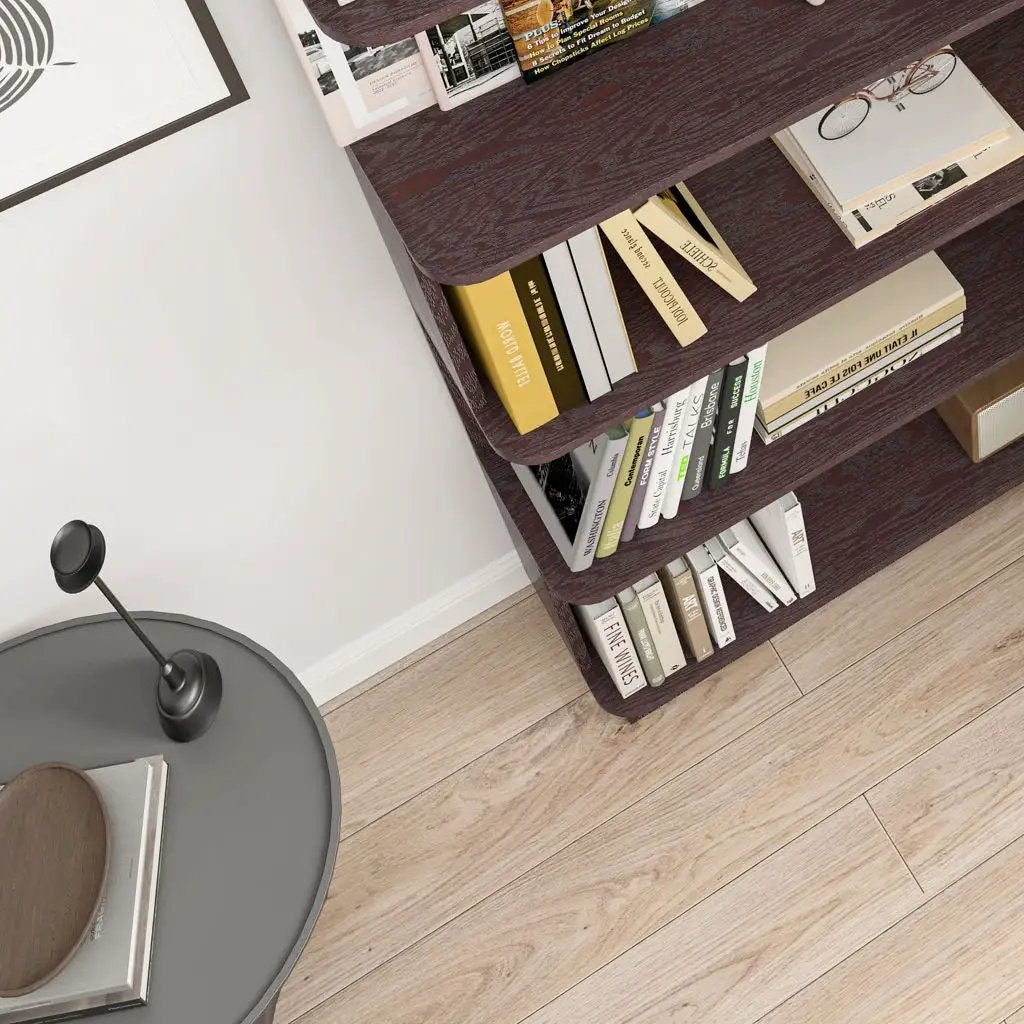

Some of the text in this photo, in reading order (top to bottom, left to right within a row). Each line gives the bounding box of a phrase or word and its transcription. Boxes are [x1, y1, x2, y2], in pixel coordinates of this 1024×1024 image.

[529, 48, 546, 59] How
[572, 22, 598, 38] Special
[599, 10, 624, 26] Rooms
[534, 36, 550, 47] Tips
[550, 31, 560, 40] to
[560, 17, 589, 35] Improve
[590, 9, 607, 20] Your
[534, 17, 649, 75] How Chopsticks Affect Log Prices
[538, 47, 566, 64] Secrets
[567, 42, 576, 50] to
[575, 36, 587, 46] Fit
[588, 25, 611, 42] Dream
[612, 20, 620, 29] to
[620, 8, 646, 24] Budget
[701, 381, 719, 429] Brisbane
[730, 375, 742, 409] SUCCESS
[744, 360, 763, 403] Houston
[661, 398, 687, 456] Harrisburg
[682, 393, 703, 450] TALKS
[640, 426, 661, 486] FORM STYLE
[584, 499, 607, 557] WASHINGTON
[604, 621, 639, 686] FINE WINES
